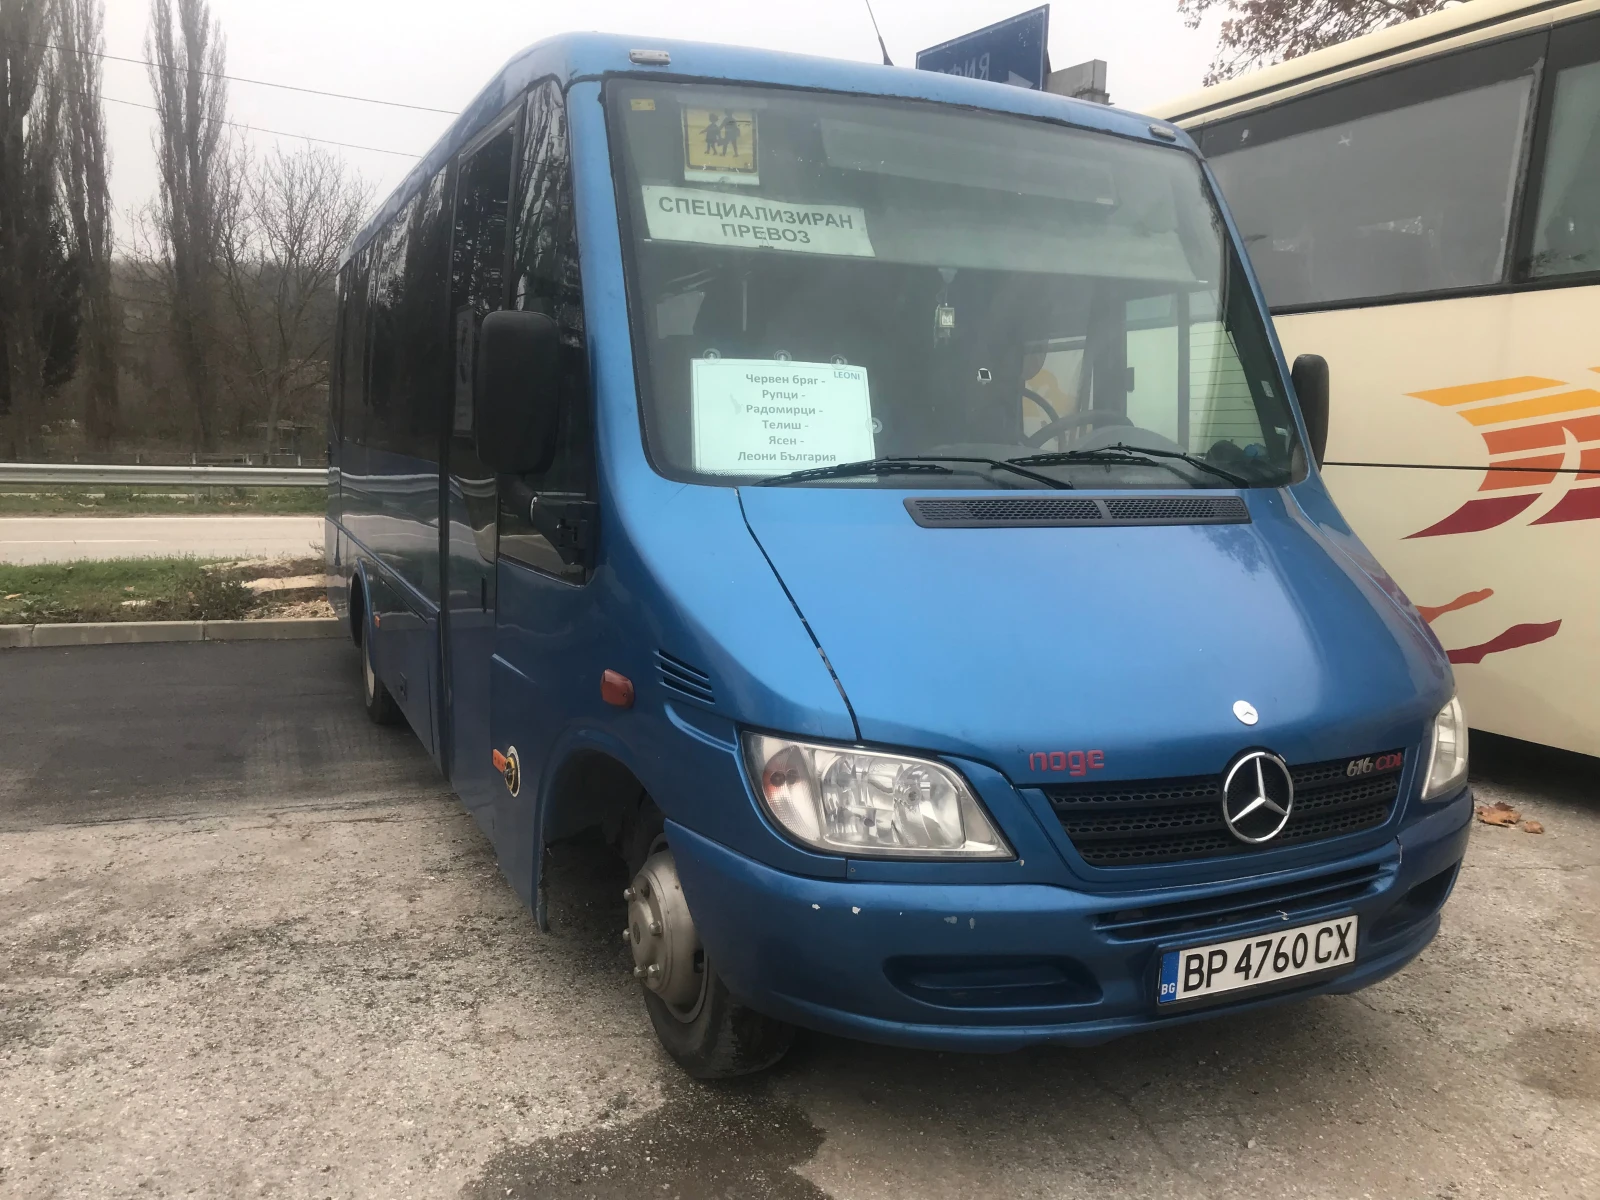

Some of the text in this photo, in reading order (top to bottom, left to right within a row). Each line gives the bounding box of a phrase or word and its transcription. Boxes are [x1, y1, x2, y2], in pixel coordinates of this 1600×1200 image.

[658, 196, 853, 230] СПЕЦИАЛИЗИРАН
[721, 223, 811, 244] ПРЕВОЗ
[746, 374, 789, 385] Червен
[792, 374, 818, 387] бряг
[833, 371, 860, 381] LEONI
[762, 389, 798, 401] Рупци
[746, 404, 816, 417] Радомирци
[762, 420, 801, 430] Телиш
[769, 436, 797, 445] Ясен
[738, 452, 836, 463] Леони България
[1029, 749, 1104, 777] noge
[1347, 757, 1373, 777] 616
[1183, 922, 1352, 992] BP 4760 CX
[1161, 982, 1176, 996] BG
